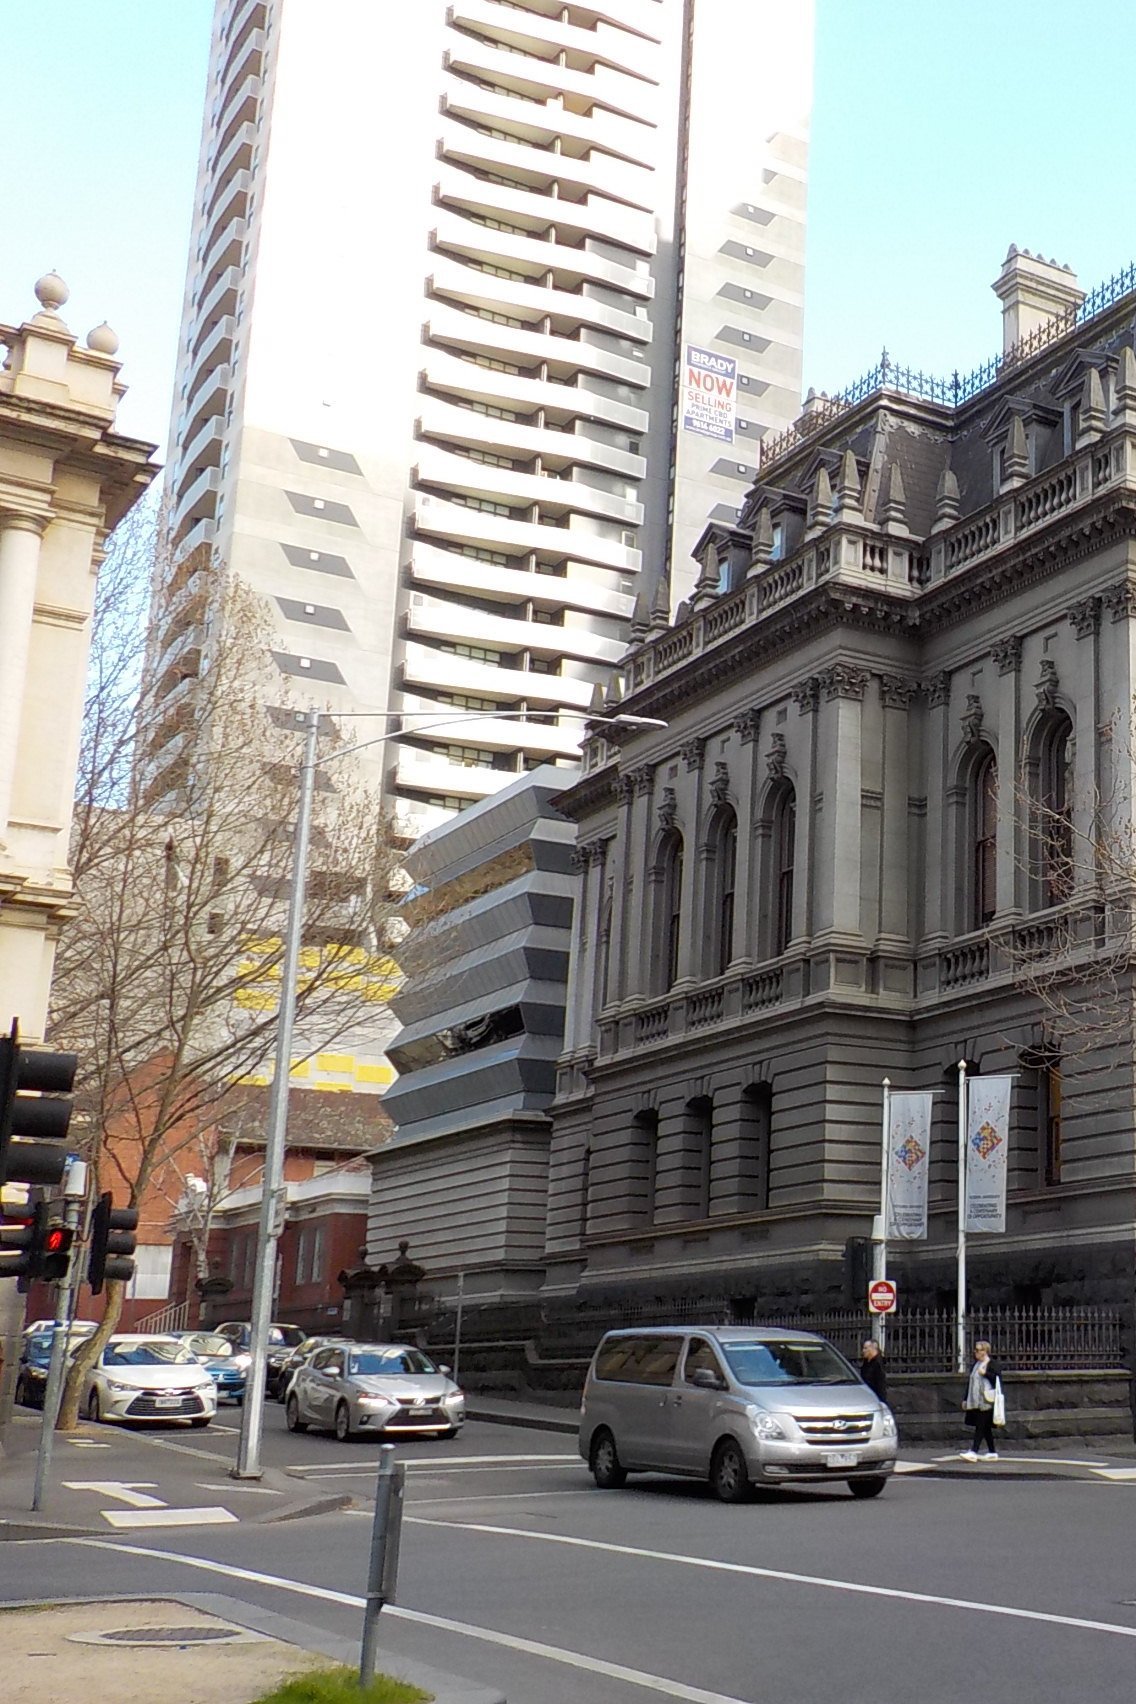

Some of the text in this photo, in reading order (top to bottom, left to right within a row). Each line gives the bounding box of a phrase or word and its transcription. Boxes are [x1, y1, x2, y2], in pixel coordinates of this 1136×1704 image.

[691, 351, 734, 373] BRADY
[688, 368, 734, 398] NOW
[688, 391, 732, 412] SELLING
[691, 403, 728, 419] PRIME CBD
[685, 409, 732, 428] APARTMENTS
